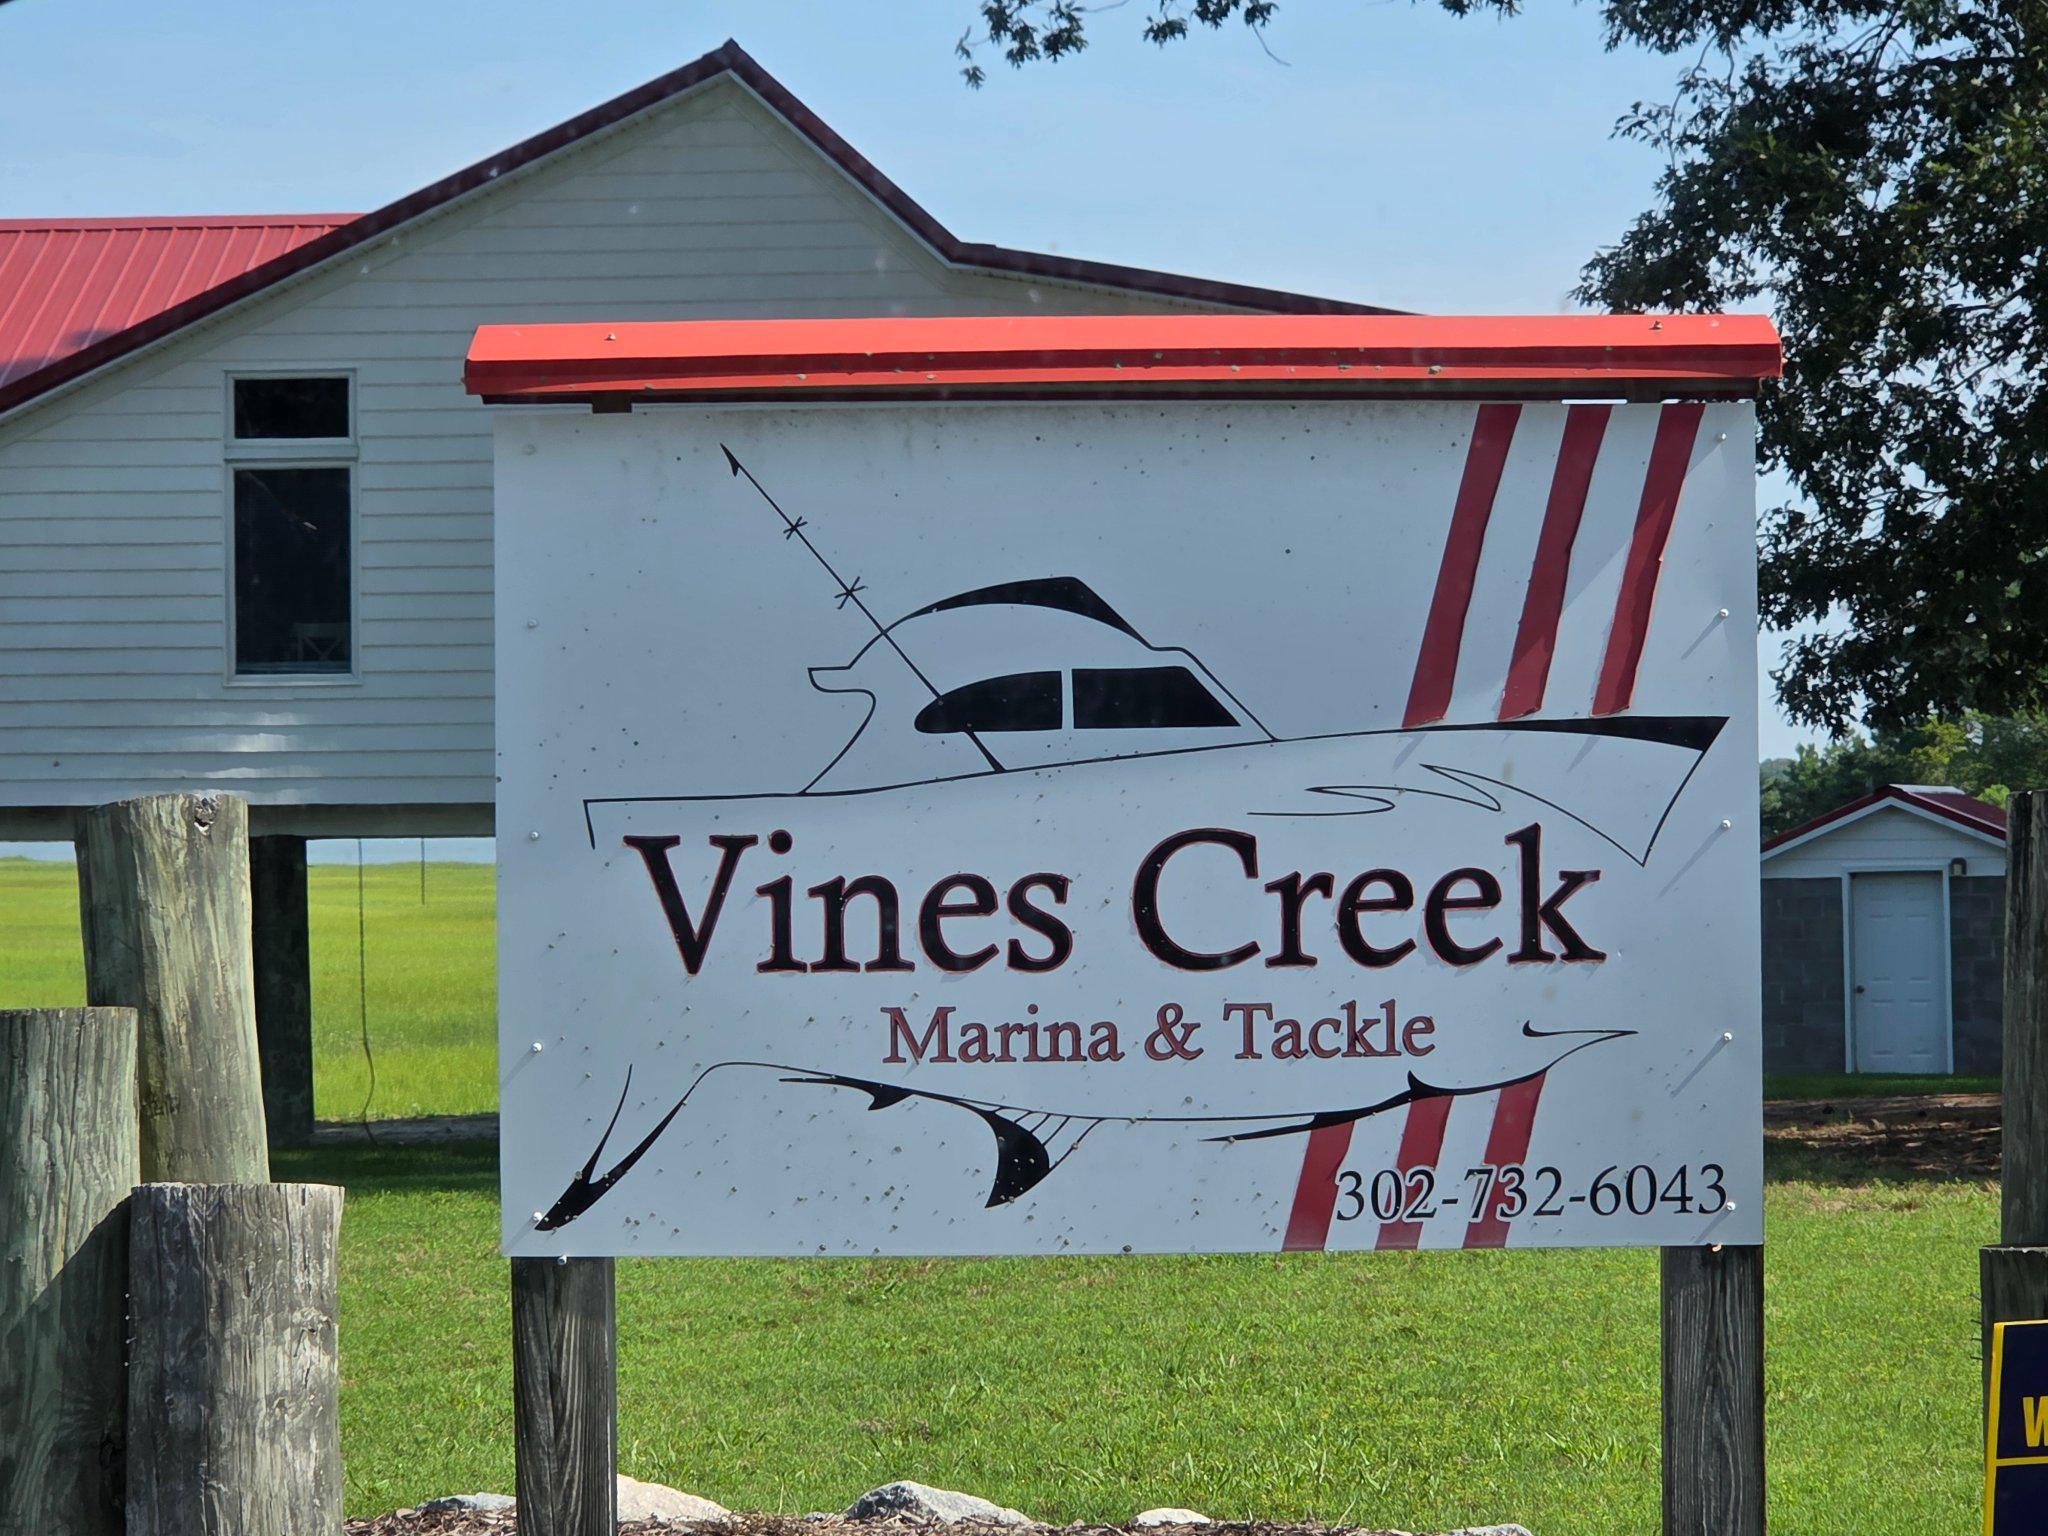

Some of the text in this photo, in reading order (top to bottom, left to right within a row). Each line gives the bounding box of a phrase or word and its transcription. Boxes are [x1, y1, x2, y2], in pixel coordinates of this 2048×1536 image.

[622, 822, 1607, 975] Vines Creek
[880, 999, 1436, 1064] Marina & Tackle
[1336, 1164, 1728, 1221] 302-732-6043
